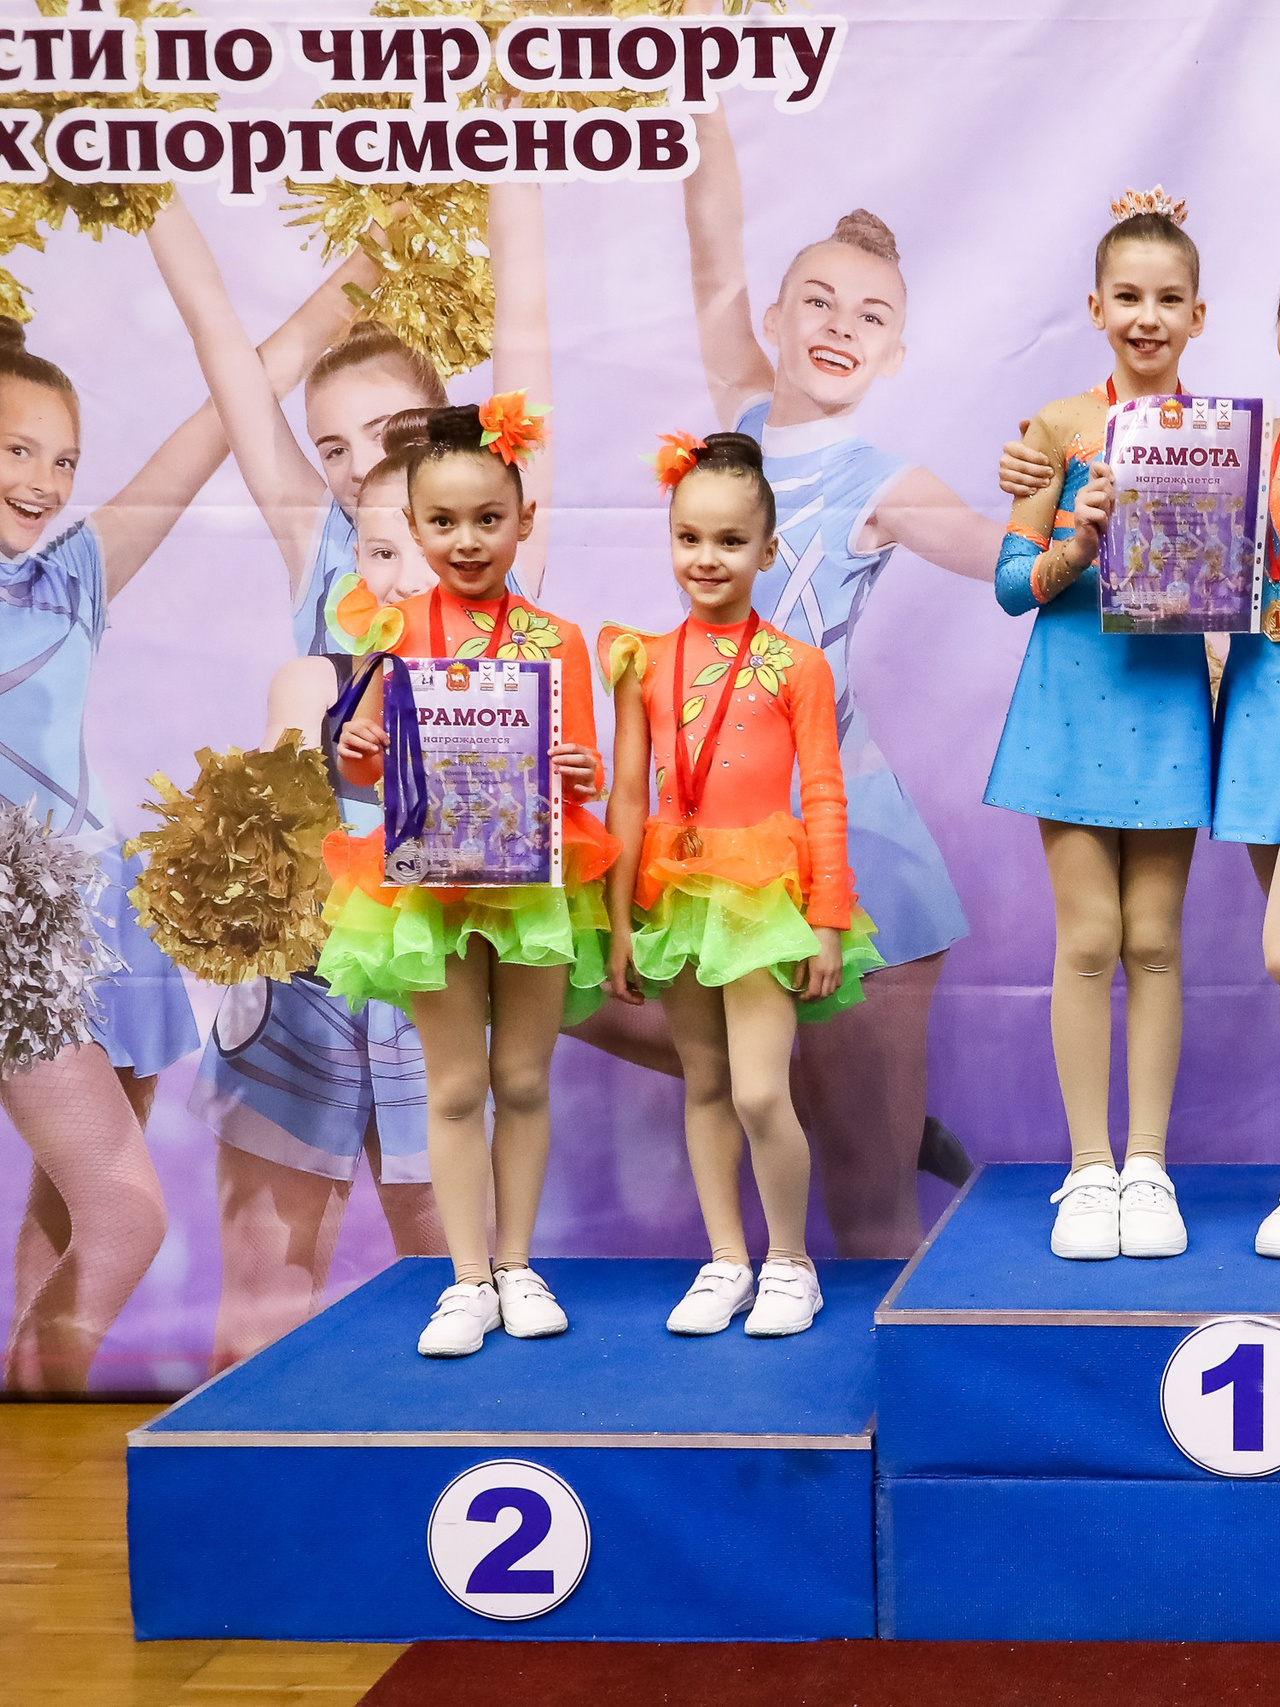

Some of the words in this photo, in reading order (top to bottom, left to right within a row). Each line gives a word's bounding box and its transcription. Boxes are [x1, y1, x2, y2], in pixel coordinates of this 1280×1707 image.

[154, 28, 273, 82] по
[300, 28, 483, 103] чир
[507, 26, 837, 102] спорту
[56, 118, 689, 195] спортсменов
[1117, 446, 1241, 467] ГРАМОТА
[1136, 475, 1221, 485] награждается
[1272, 610, 1280, 629] 1
[417, 707, 530, 727] РАМОТА
[423, 736, 510, 745] награждается
[395, 860, 415, 871] 2
[1201, 1343, 1264, 1452] 1
[465, 1487, 555, 1594] 2
